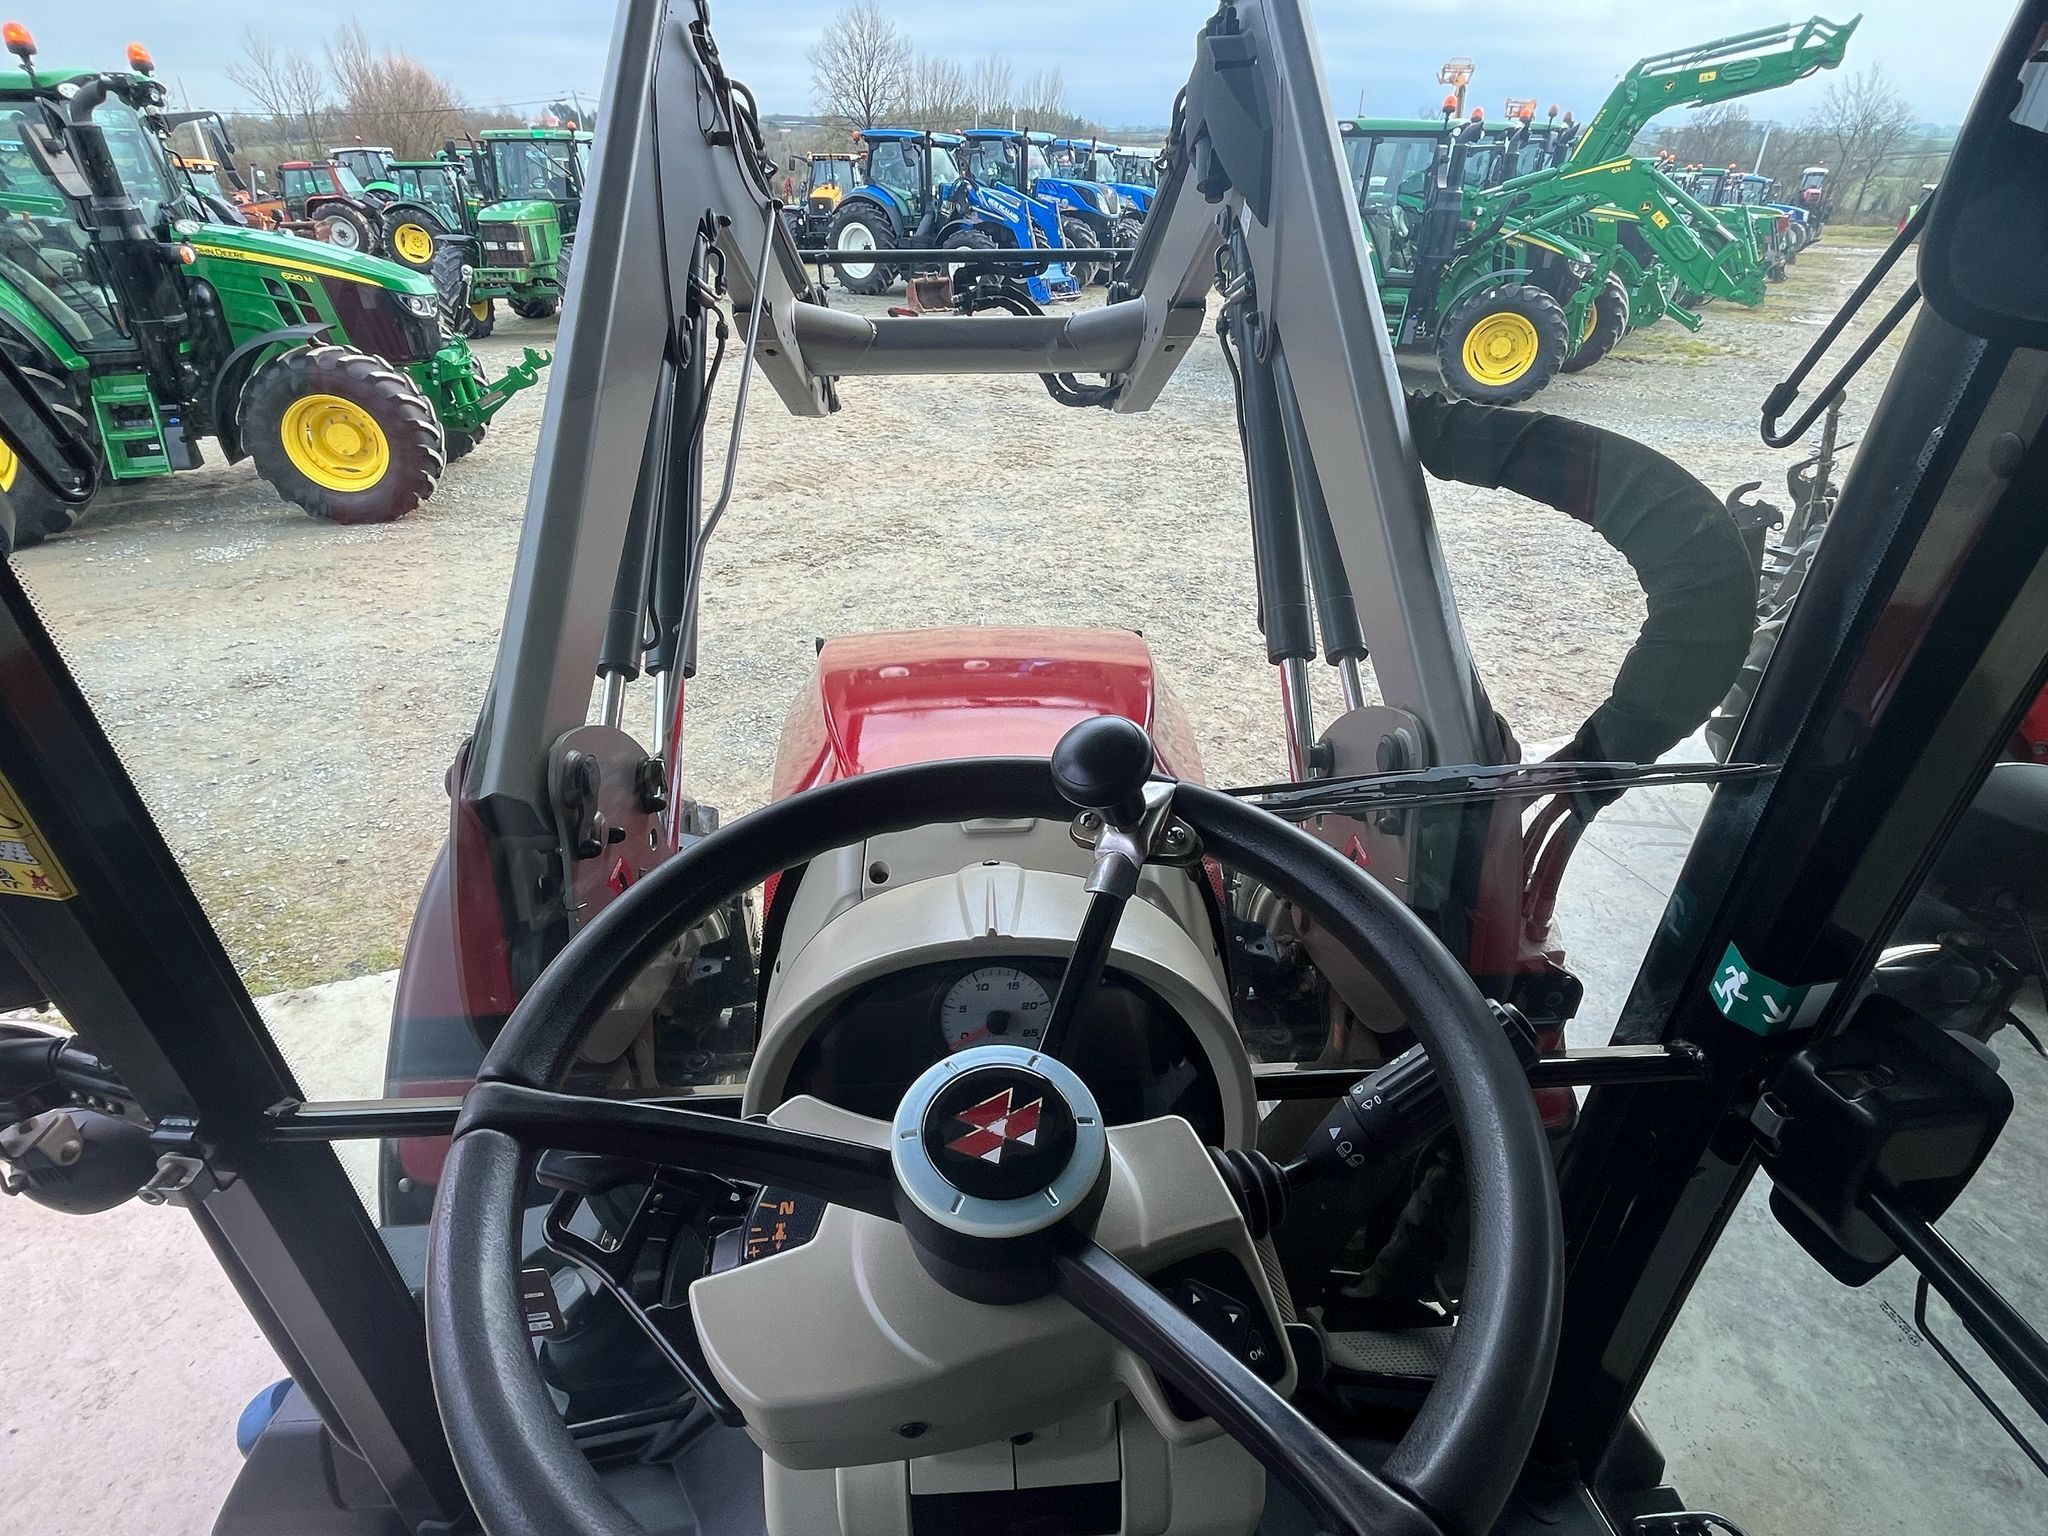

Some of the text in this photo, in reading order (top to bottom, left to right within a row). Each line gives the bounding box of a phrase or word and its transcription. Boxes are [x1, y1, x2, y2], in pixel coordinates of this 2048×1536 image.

[214, 248, 245, 260] DEERE
[975, 983, 990, 991] 10
[1006, 981, 1020, 990] 15
[959, 1005, 967, 1013] 5
[1021, 1002, 1039, 1010] 20
[1022, 1029, 1039, 1037] 25
[1249, 1347, 1265, 1361] OK
